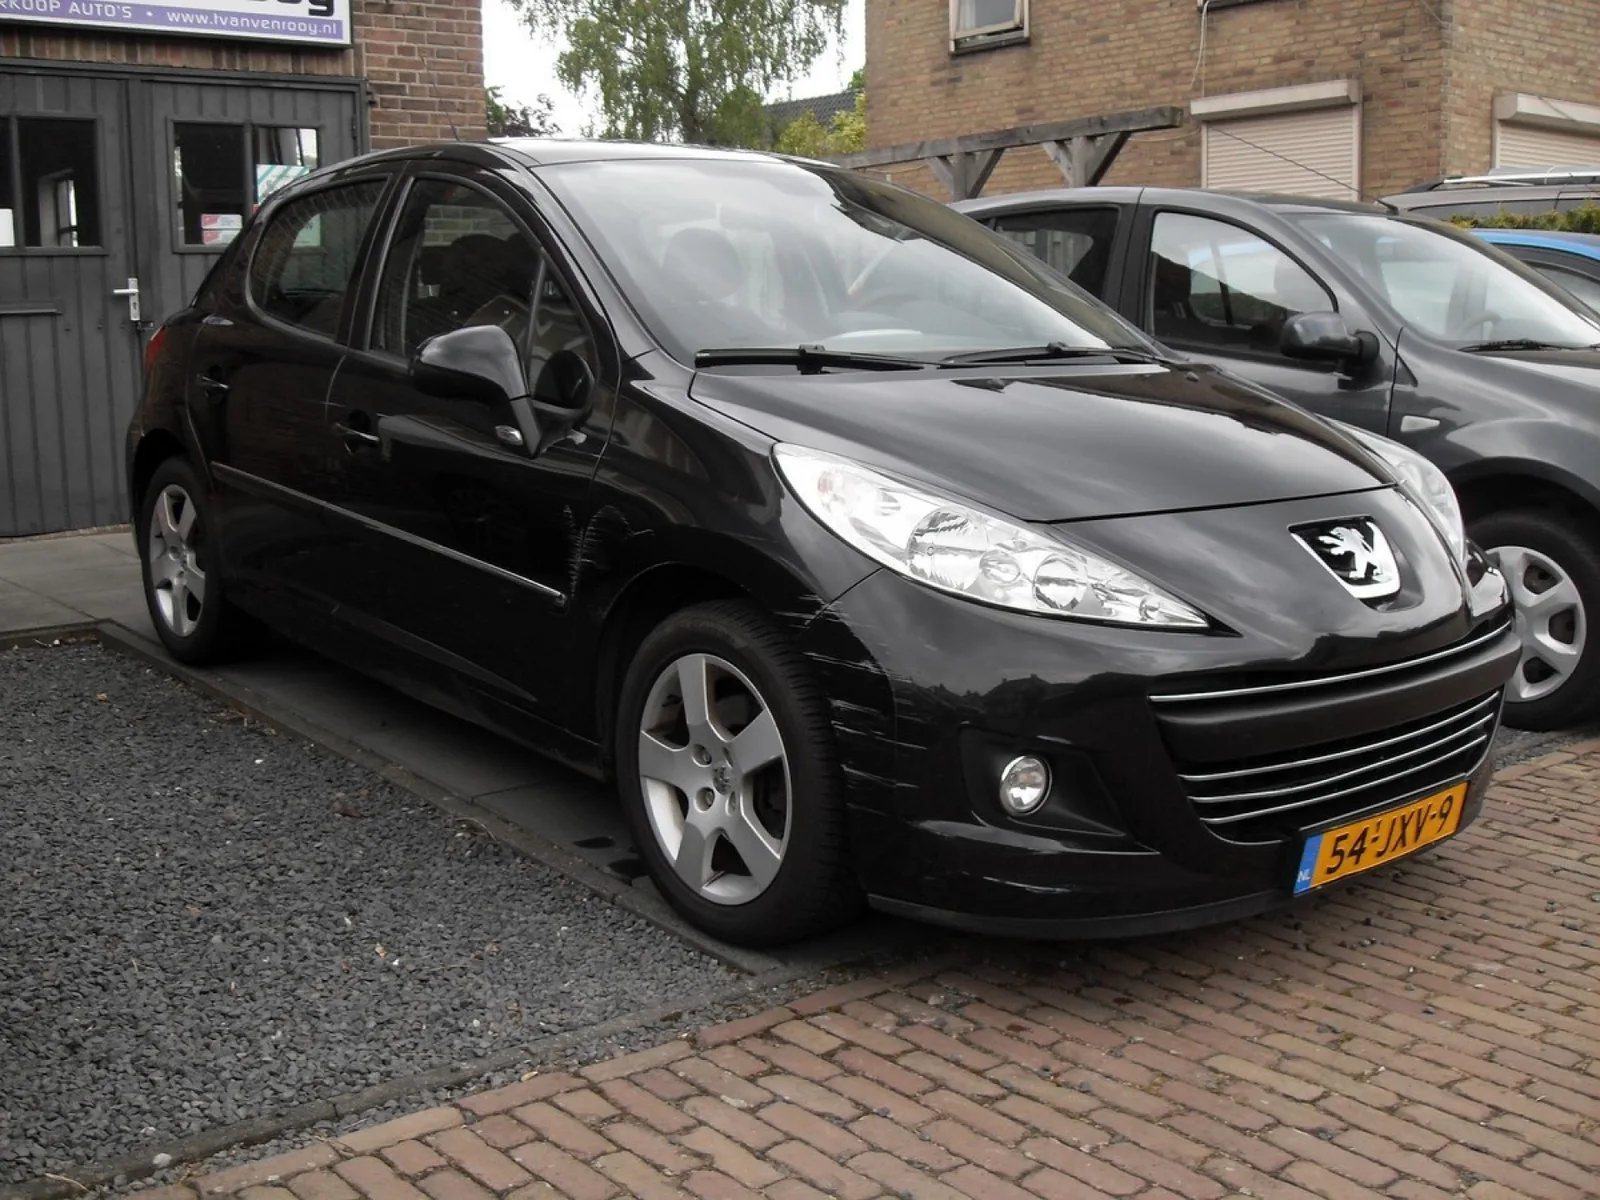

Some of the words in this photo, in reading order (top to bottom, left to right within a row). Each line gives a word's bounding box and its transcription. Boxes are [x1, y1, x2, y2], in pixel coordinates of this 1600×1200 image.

[68, 2, 132, 18] AUTO'S
[1326, 794, 1454, 875] 54-JXV-9
[1297, 869, 1311, 883] NL
